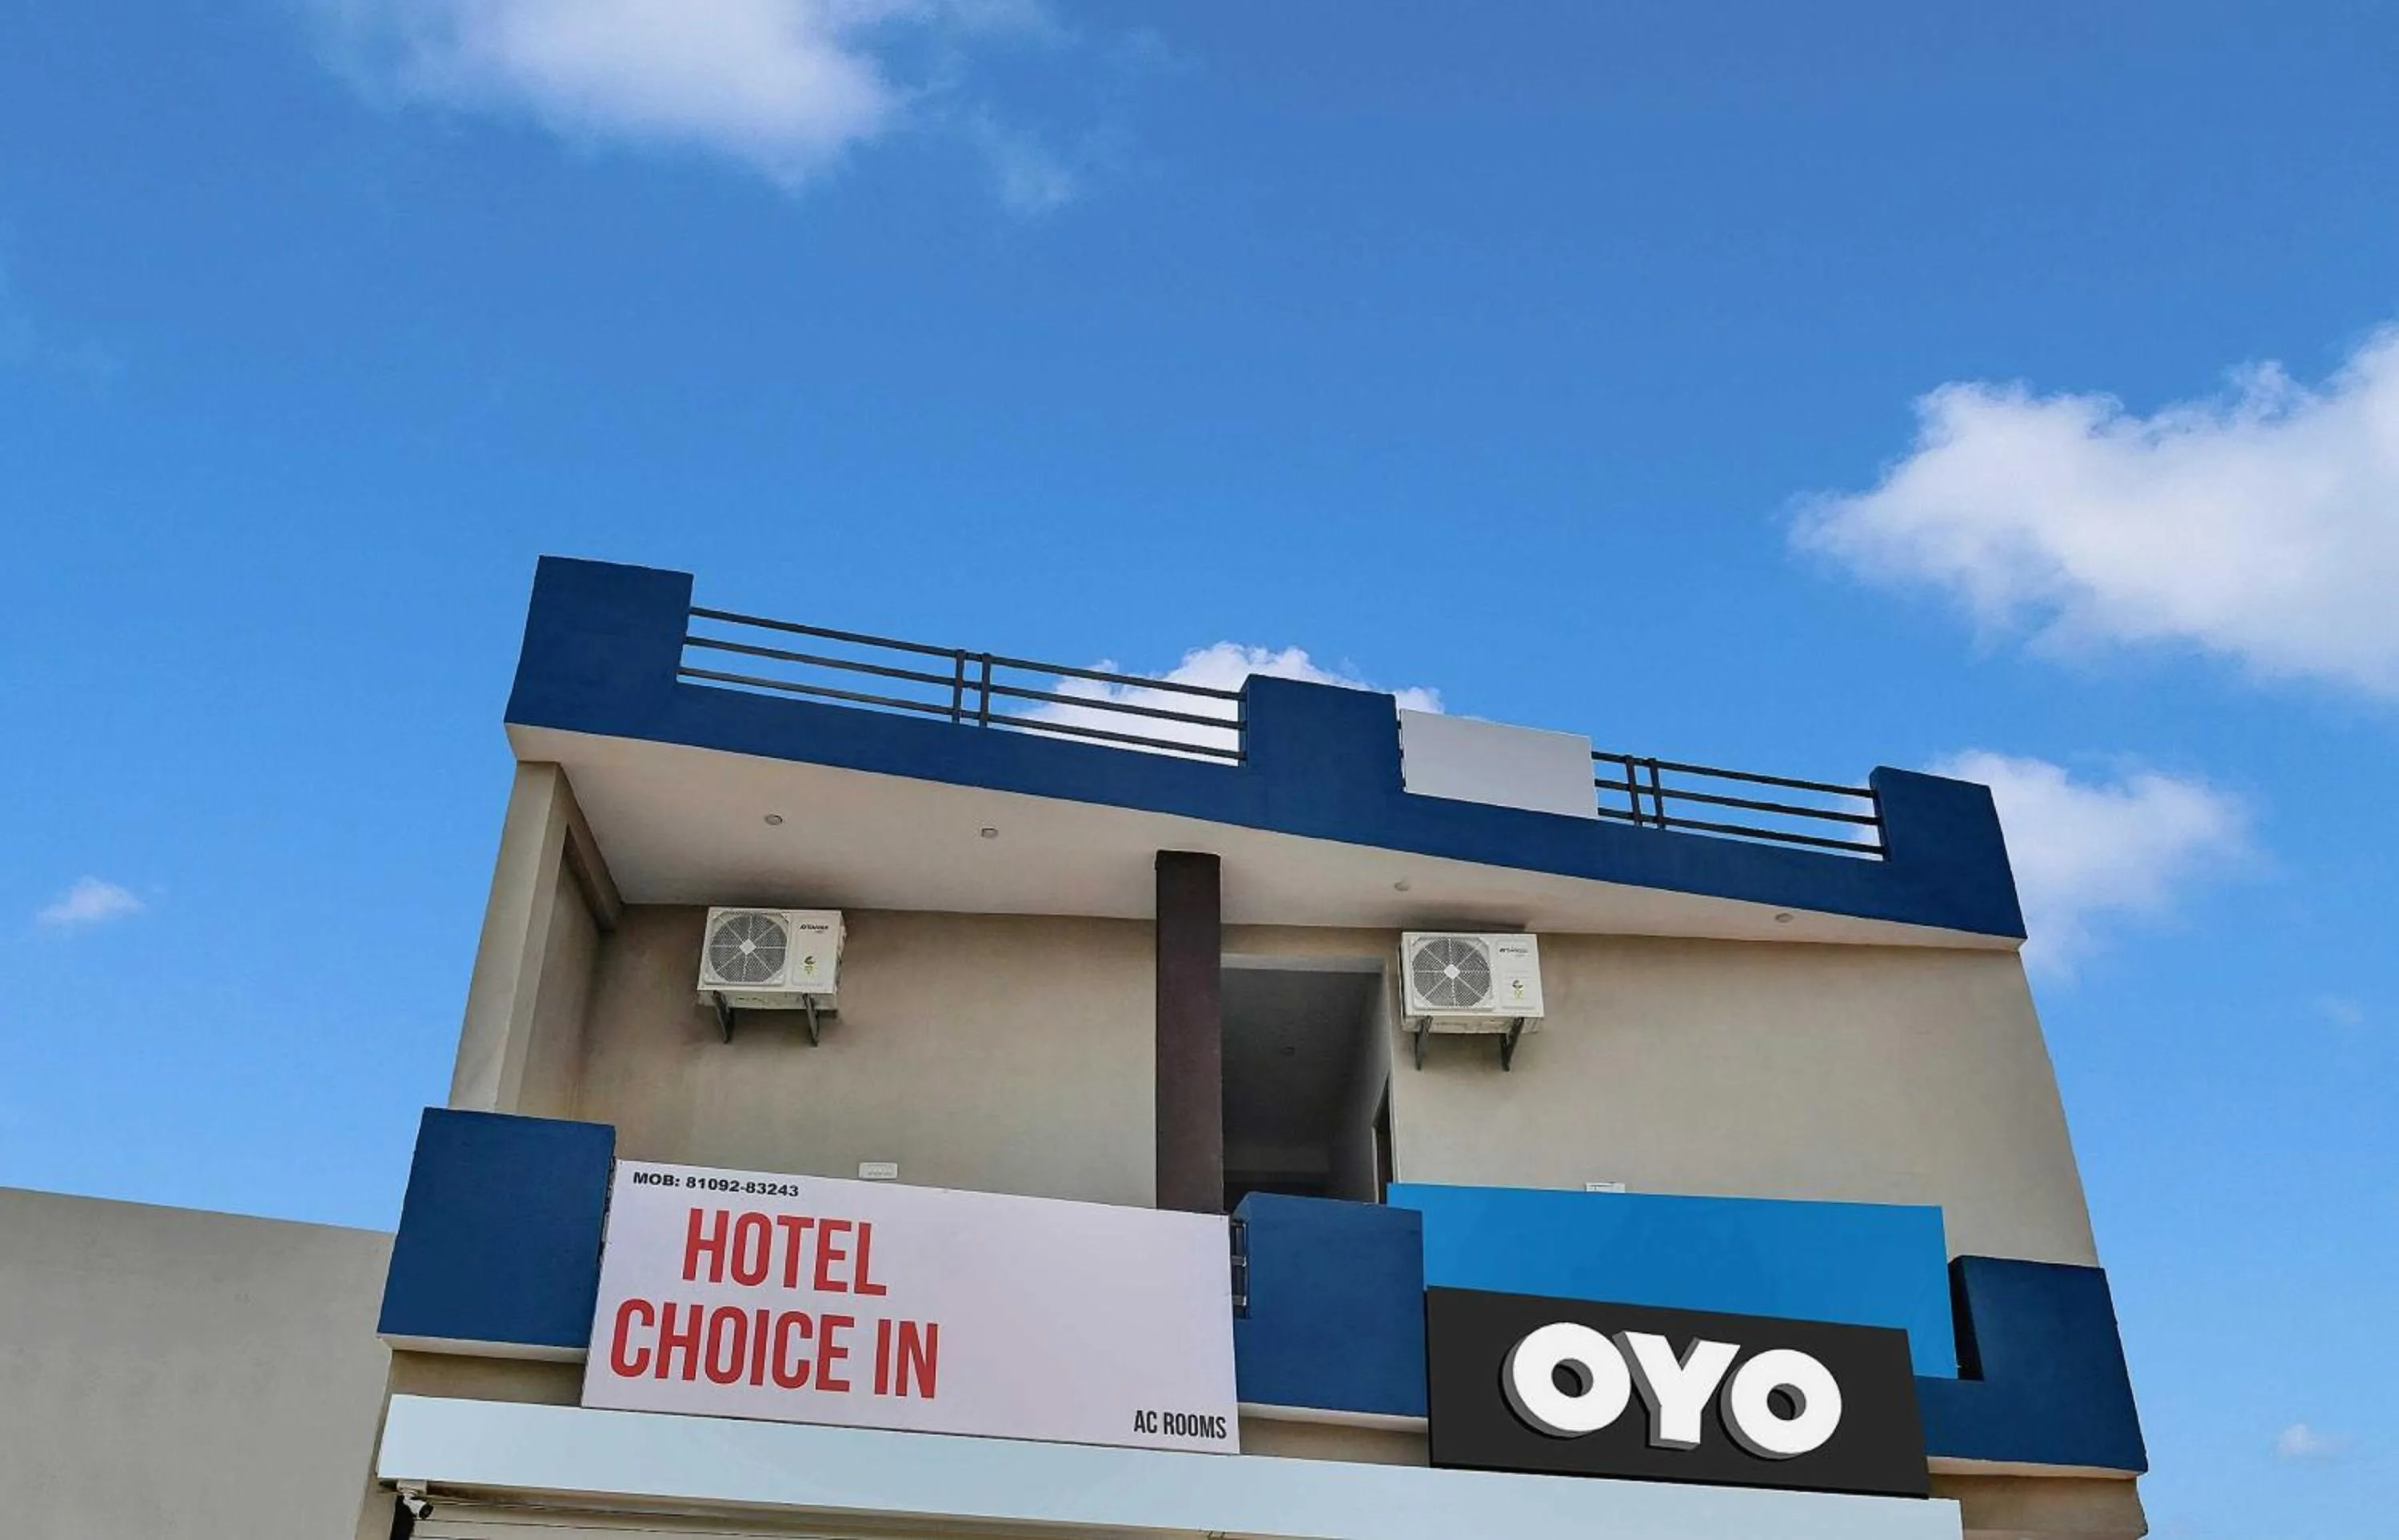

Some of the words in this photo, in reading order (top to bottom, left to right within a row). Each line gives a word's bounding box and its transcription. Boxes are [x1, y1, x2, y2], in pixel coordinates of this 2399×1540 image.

[633, 1171, 681, 1187] MOB:
[685, 1176, 799, 1197] 81092-83243
[682, 1207, 887, 1296] HOTEL
[610, 1298, 855, 1393] CHOICE
[874, 1318, 939, 1398] IN
[1500, 1321, 1842, 1460] OYO
[1133, 1410, 1157, 1434] AC
[1164, 1412, 1227, 1439] ROOMS
